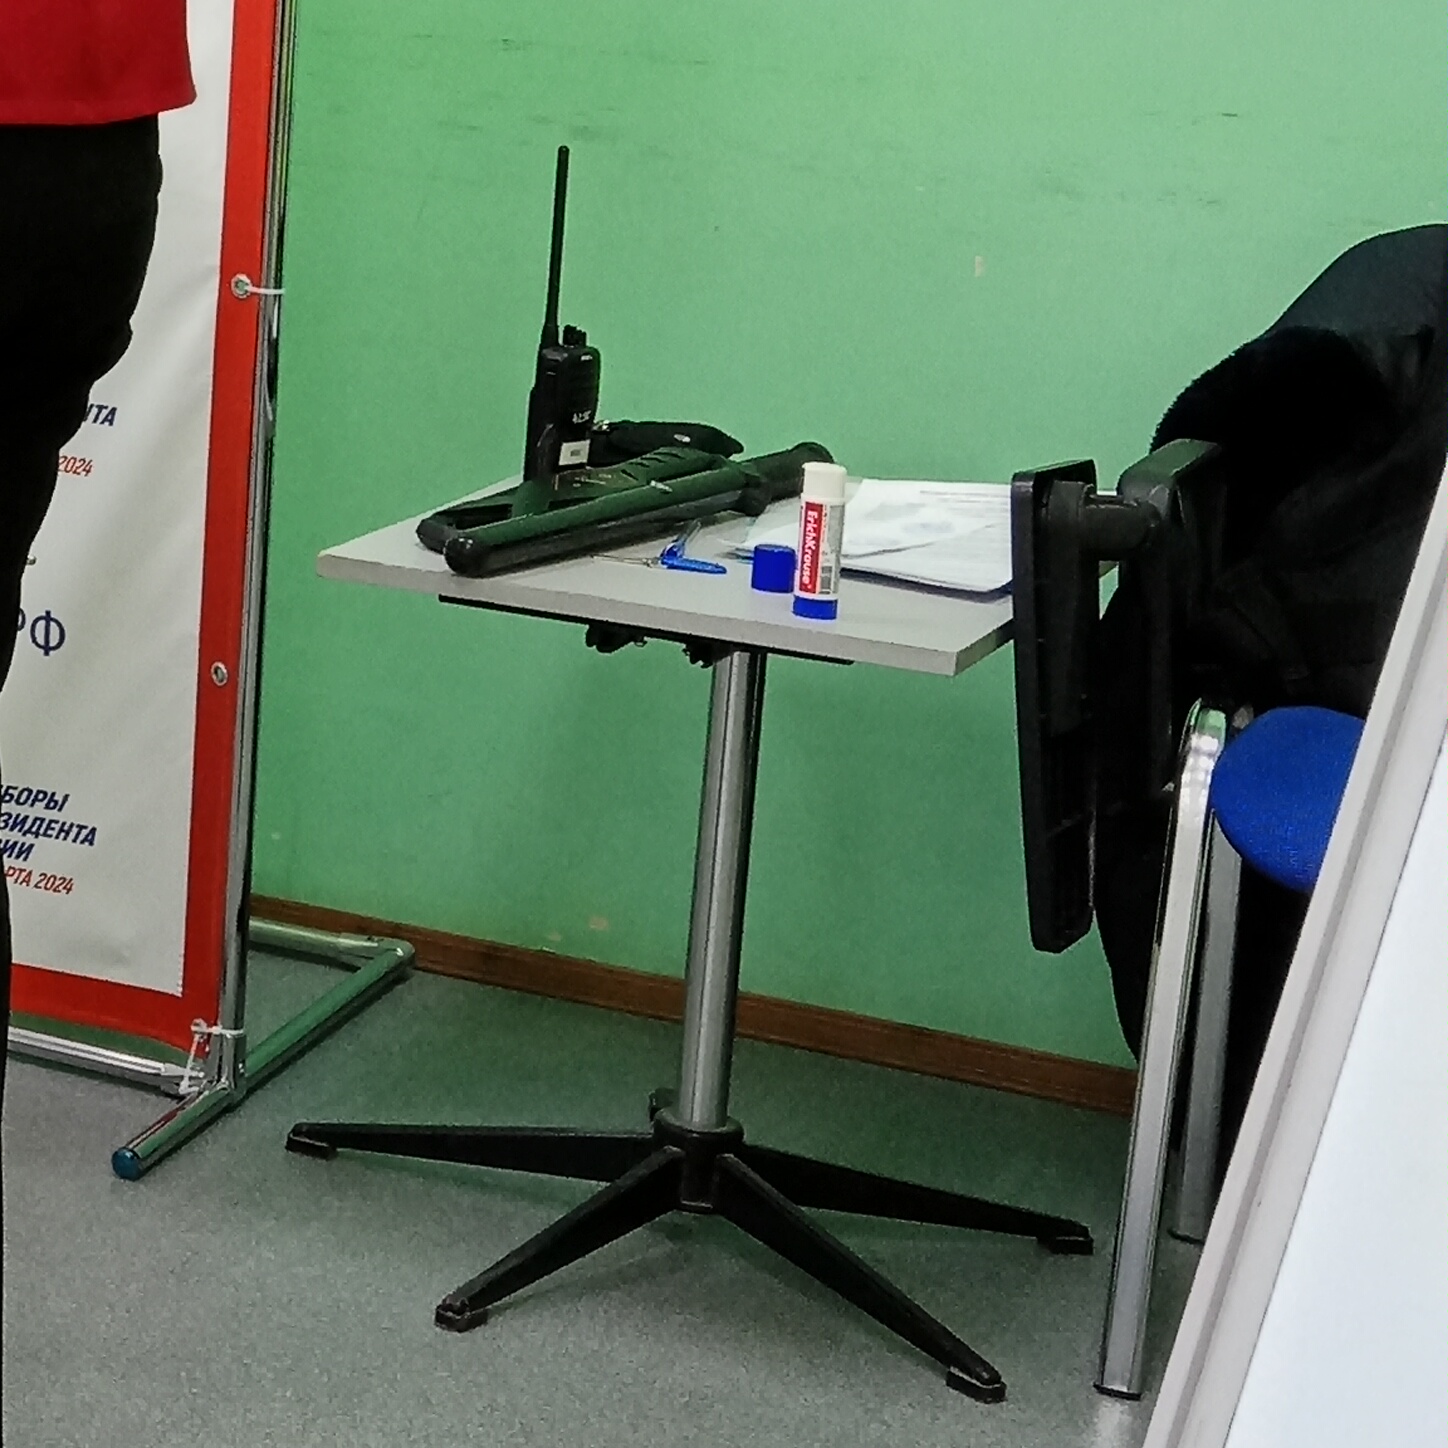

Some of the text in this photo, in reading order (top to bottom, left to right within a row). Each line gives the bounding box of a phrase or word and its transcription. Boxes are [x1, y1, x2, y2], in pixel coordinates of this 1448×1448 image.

[1, 785, 70, 812] БОРЫ
[0, 812, 97, 846] ЗИДЕНТА
[5, 866, 74, 894] РТА 2024
